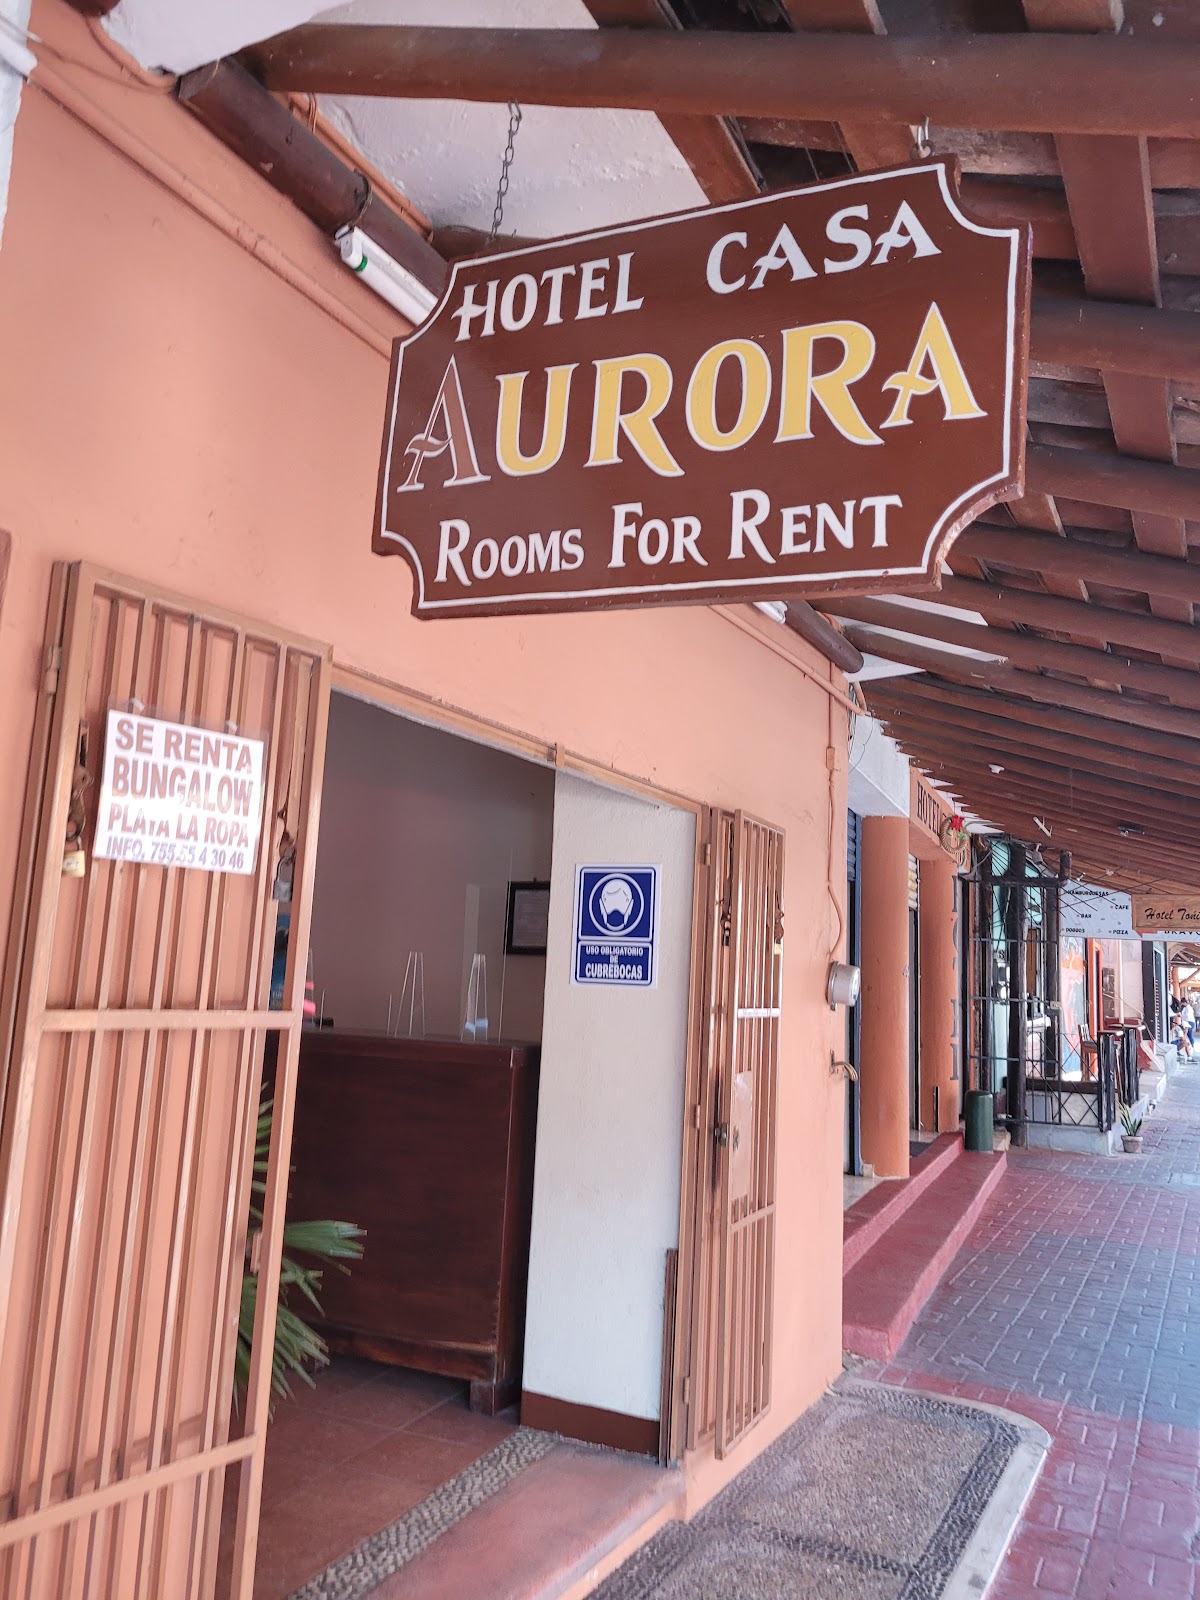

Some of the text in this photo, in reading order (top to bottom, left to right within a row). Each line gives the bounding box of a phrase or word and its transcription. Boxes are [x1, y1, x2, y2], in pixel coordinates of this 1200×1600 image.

[452, 200, 942, 342] HOTEL CASA
[396, 301, 988, 492] AURORA
[434, 488, 903, 585] ROOMS FOR RENT
[115, 719, 252, 774] SE RENTA
[112, 755, 253, 817] BUNGALOW
[175, 813, 198, 842] LA
[204, 817, 248, 848] ROPA
[917, 780, 940, 838] HOTEL
[211, 848, 226, 867] 30
[229, 850, 244, 869] 46
[1145, 907, 1174, 920] Hotel
[585, 962, 643, 980] CUBREBOCAS
[586, 945, 644, 957] USO OBLIGATORIO
[609, 955, 619, 963] DE
